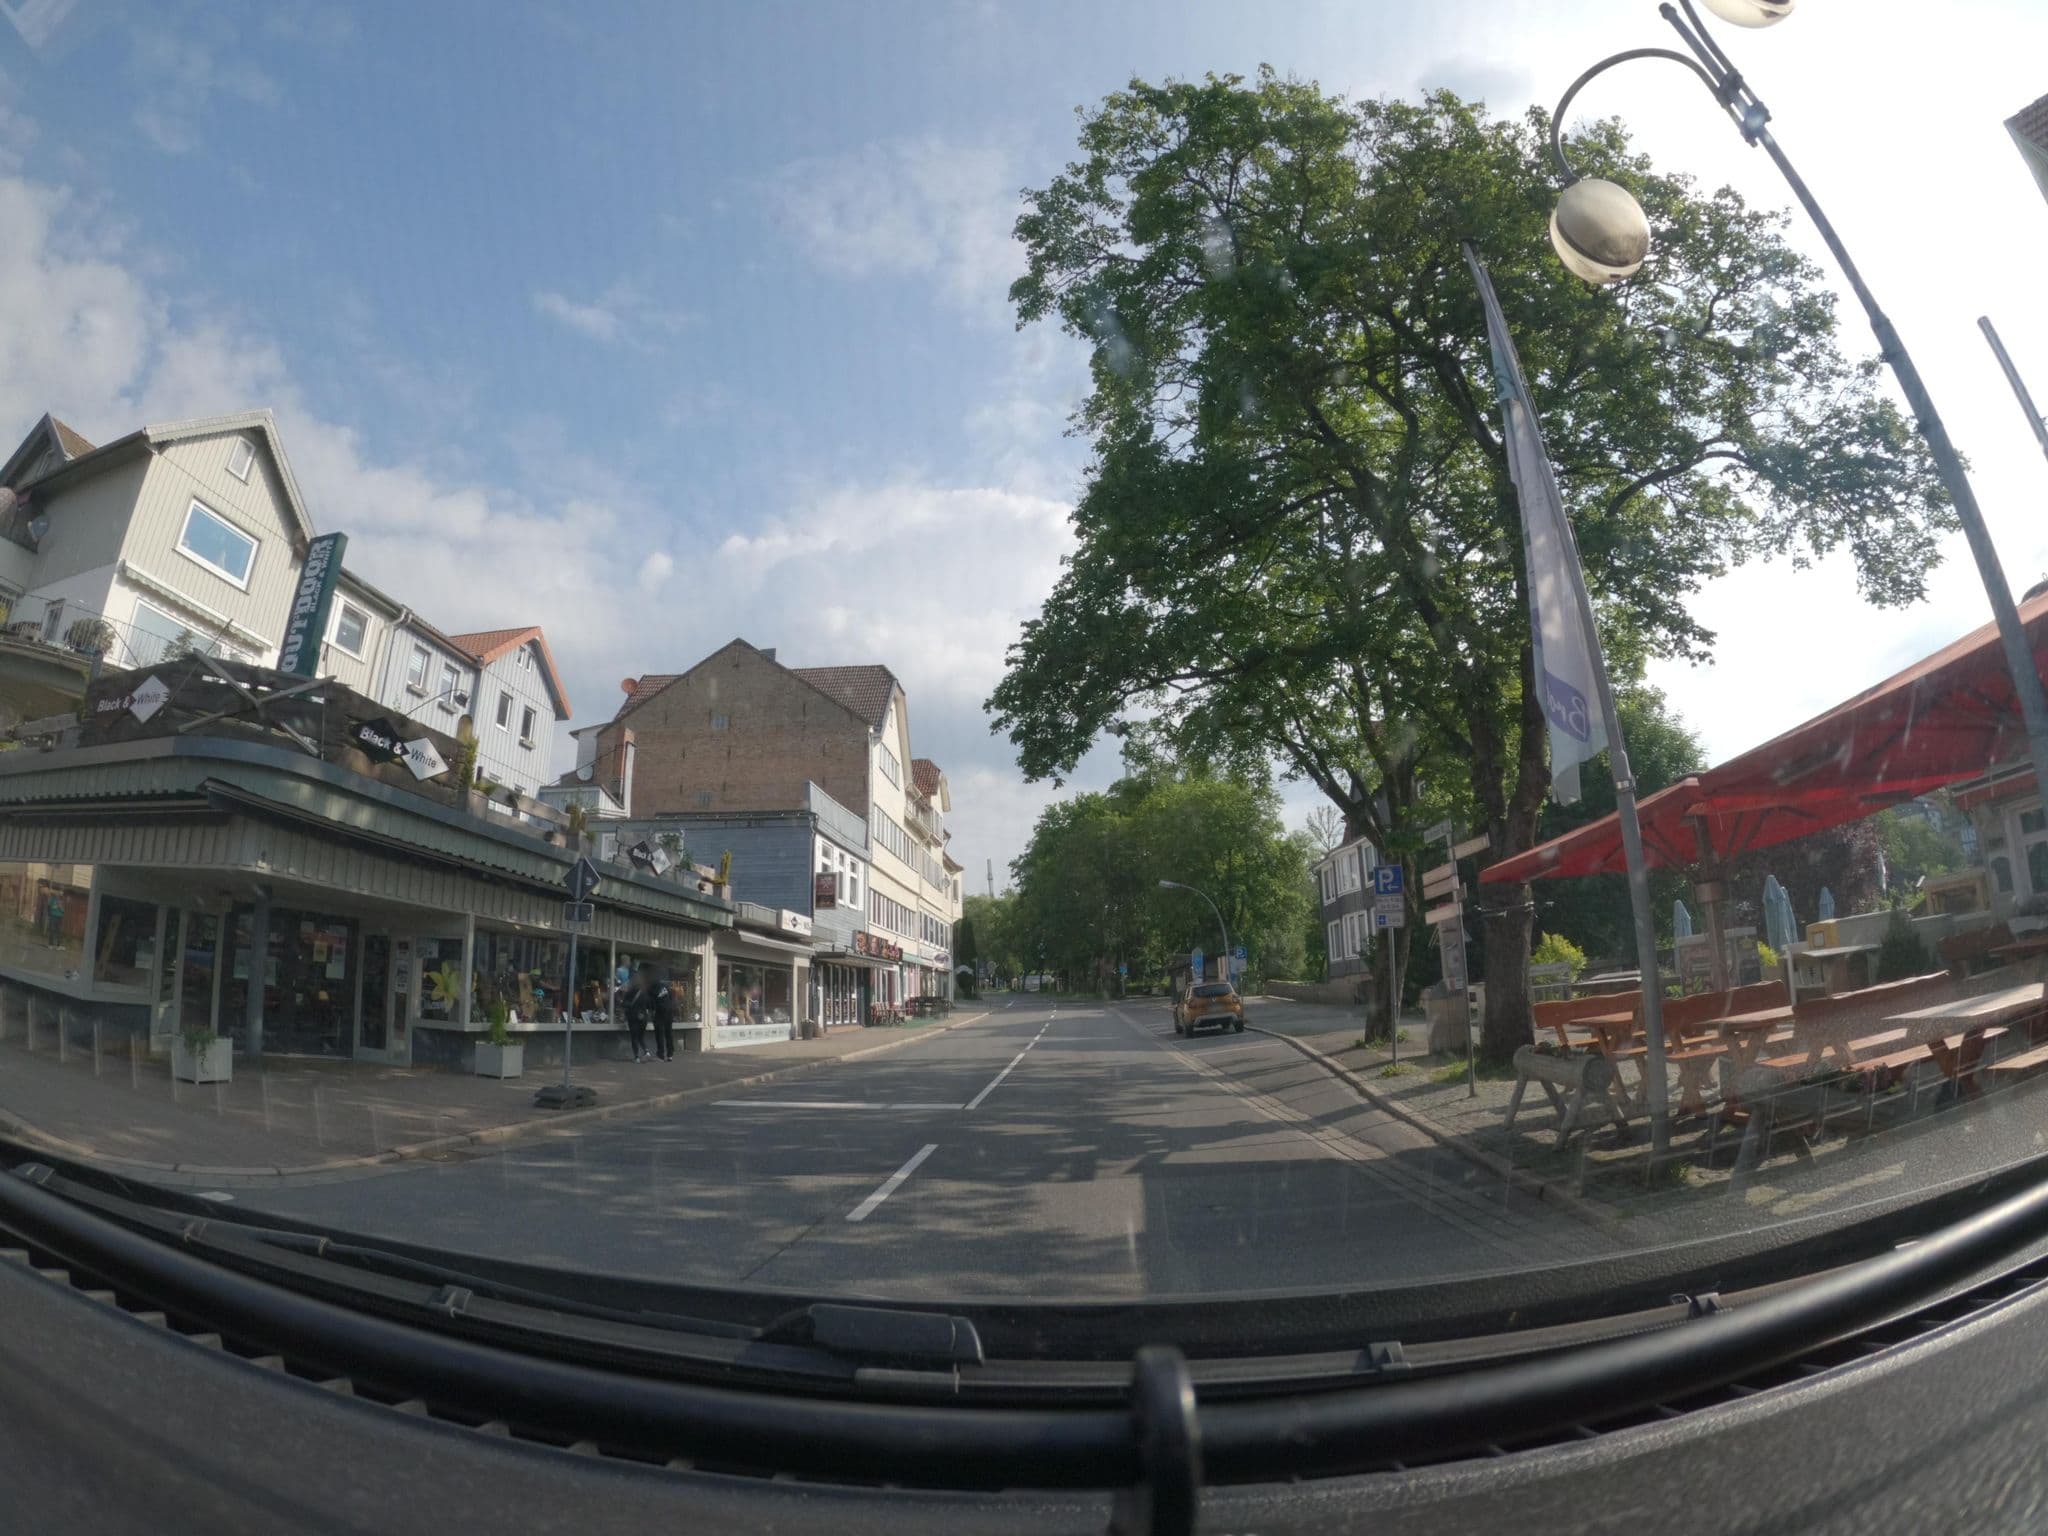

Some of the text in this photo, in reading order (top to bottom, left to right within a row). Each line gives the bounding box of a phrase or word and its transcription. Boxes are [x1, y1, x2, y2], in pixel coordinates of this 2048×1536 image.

[281, 540, 328, 673] OUTDOOR
[97, 697, 121, 713] Black
[359, 726, 437, 768] Black & White
[1378, 869, 1394, 892] P
